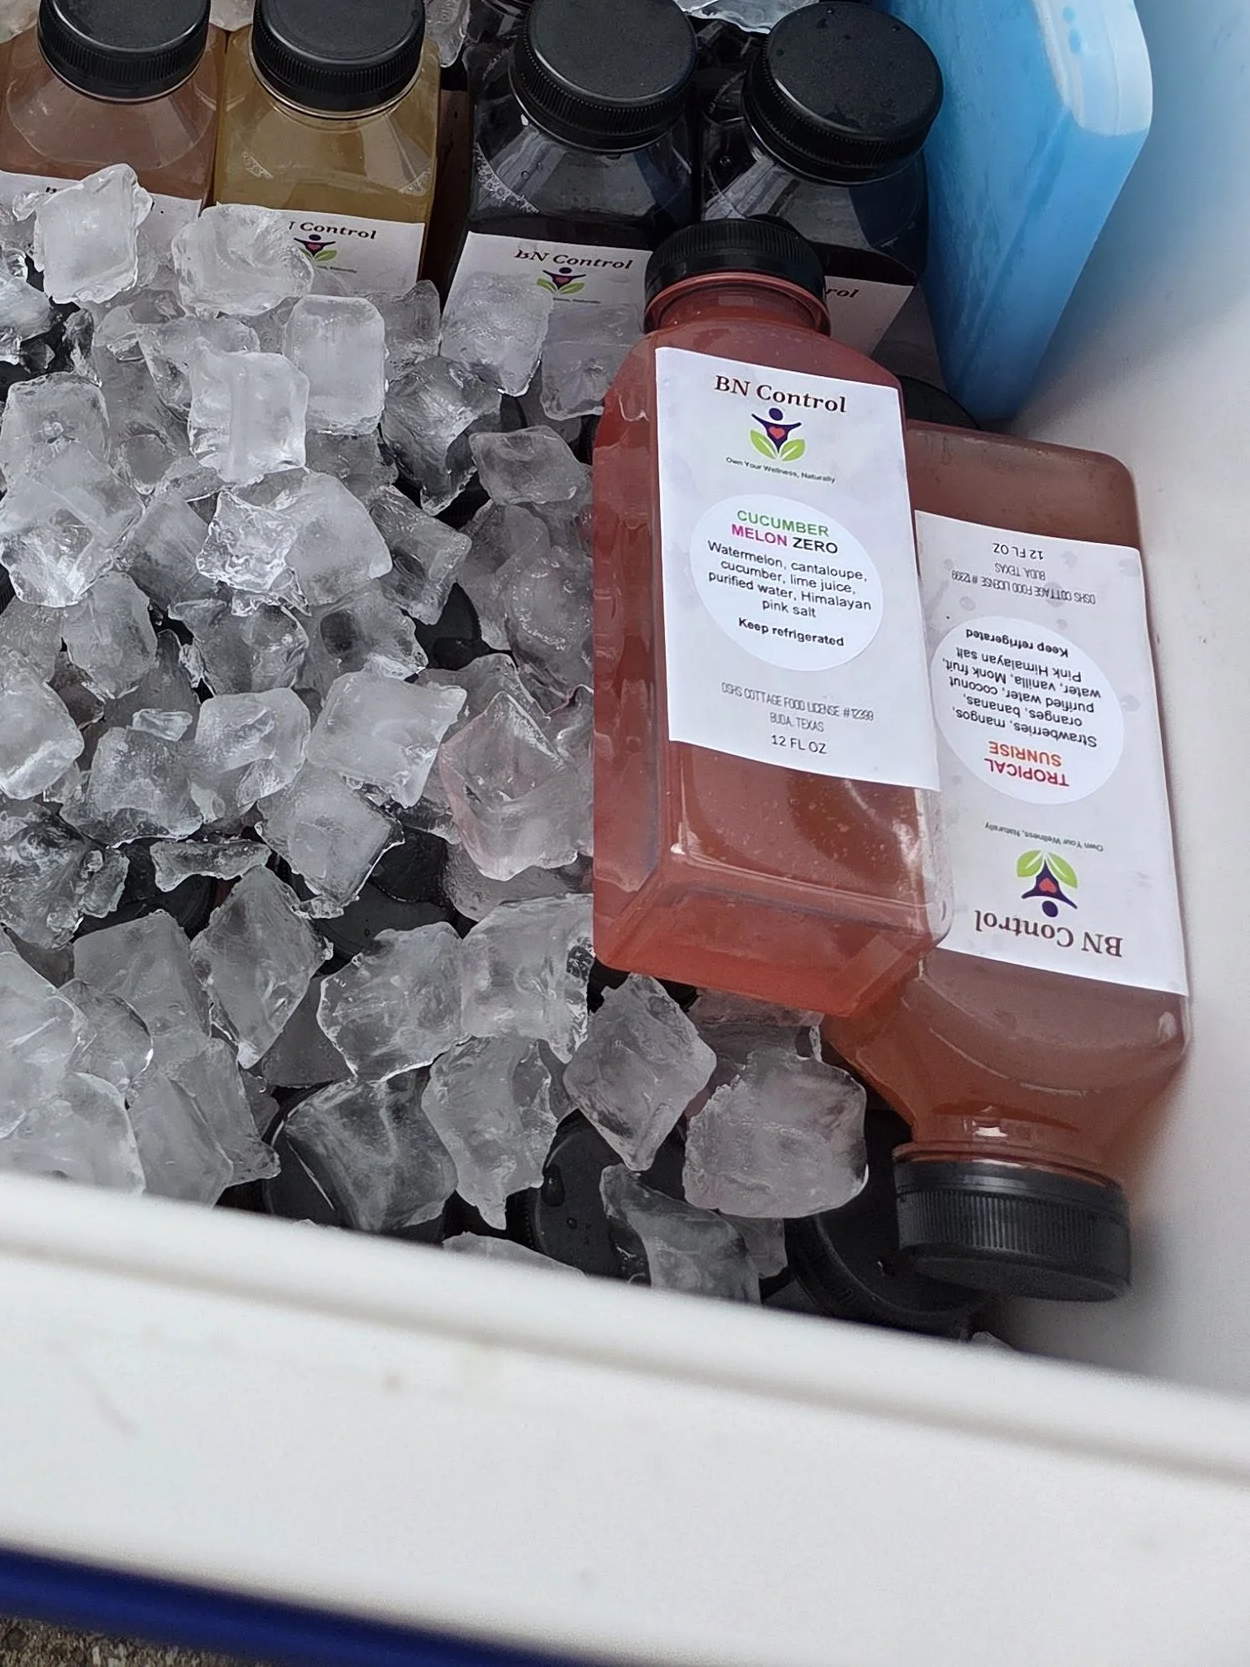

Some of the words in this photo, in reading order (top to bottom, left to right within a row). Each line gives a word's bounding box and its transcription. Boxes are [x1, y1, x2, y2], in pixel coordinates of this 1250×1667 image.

[300, 222, 377, 239] Control
[552, 254, 633, 270] Control
[714, 375, 751, 397] BN
[756, 384, 847, 413] Control
[725, 457, 743, 466] Own
[744, 461, 762, 470] Your
[763, 465, 800, 478] Wellness,
[801, 472, 836, 484] Naturally
[737, 510, 829, 537] CUCUMBER
[731, 524, 788, 546] MELON
[792, 537, 838, 554] ZERO
[993, 543, 1009, 555] OZ
[1012, 547, 1026, 558] FL
[1029, 550, 1044, 560] 12
[707, 540, 787, 570] Watermelon,
[790, 562, 868, 582] cantaloupe,
[995, 563, 1021, 576] TEXAS
[720, 560, 786, 584] cucumber,
[790, 574, 817, 588] lime
[820, 579, 856, 595] juice,
[981, 576, 1010, 590] LICENSE
[708, 572, 754, 590] purified
[757, 584, 797, 601] water,
[801, 591, 872, 611] Himalayan
[1013, 582, 1032, 595] FOOD
[1035, 586, 1072, 601] COTTAGE
[762, 600, 789, 613] pink
[792, 606, 817, 618] salt
[738, 617, 769, 634] Keep
[772, 626, 844, 647] refrigerated
[966, 629, 1033, 649] refrigerated
[956, 647, 977, 658] salt
[1037, 642, 1068, 657] Keep
[942, 658, 968, 672] fruit,
[982, 654, 1048, 677] Himalayan
[973, 667, 1006, 684] Monk
[1011, 674, 1056, 691] vanilla,
[1052, 668, 1081, 682] Pink
[949, 677, 998, 695] coconut
[1060, 683, 1101, 698] water,
[744, 688, 782, 707] COTTAGE
[783, 697, 805, 711] FOOD
[807, 702, 840, 717] LICENSE
[1002, 688, 1041, 704] water,
[963, 694, 1020, 717] bananas,
[1046, 697, 1094, 713] purified
[795, 717, 824, 732] TEXAS
[953, 707, 1005, 728] mangos,
[1025, 708, 1082, 726] oranges,
[1010, 720, 1097, 748] Strawberries,
[771, 734, 787, 747] 12
[790, 737, 806, 751] FL
[808, 741, 827, 754] OZ
[989, 741, 1062, 767] SUNRISE
[984, 758, 1069, 787] TROPICAL
[985, 822, 1020, 836] Naturally
[1022, 830, 1061, 845] Wellness,
[1063, 839, 1082, 849] Your
[1084, 843, 1104, 852] Own
[974, 910, 1074, 948] Control
[1081, 931, 1123, 957] BN
